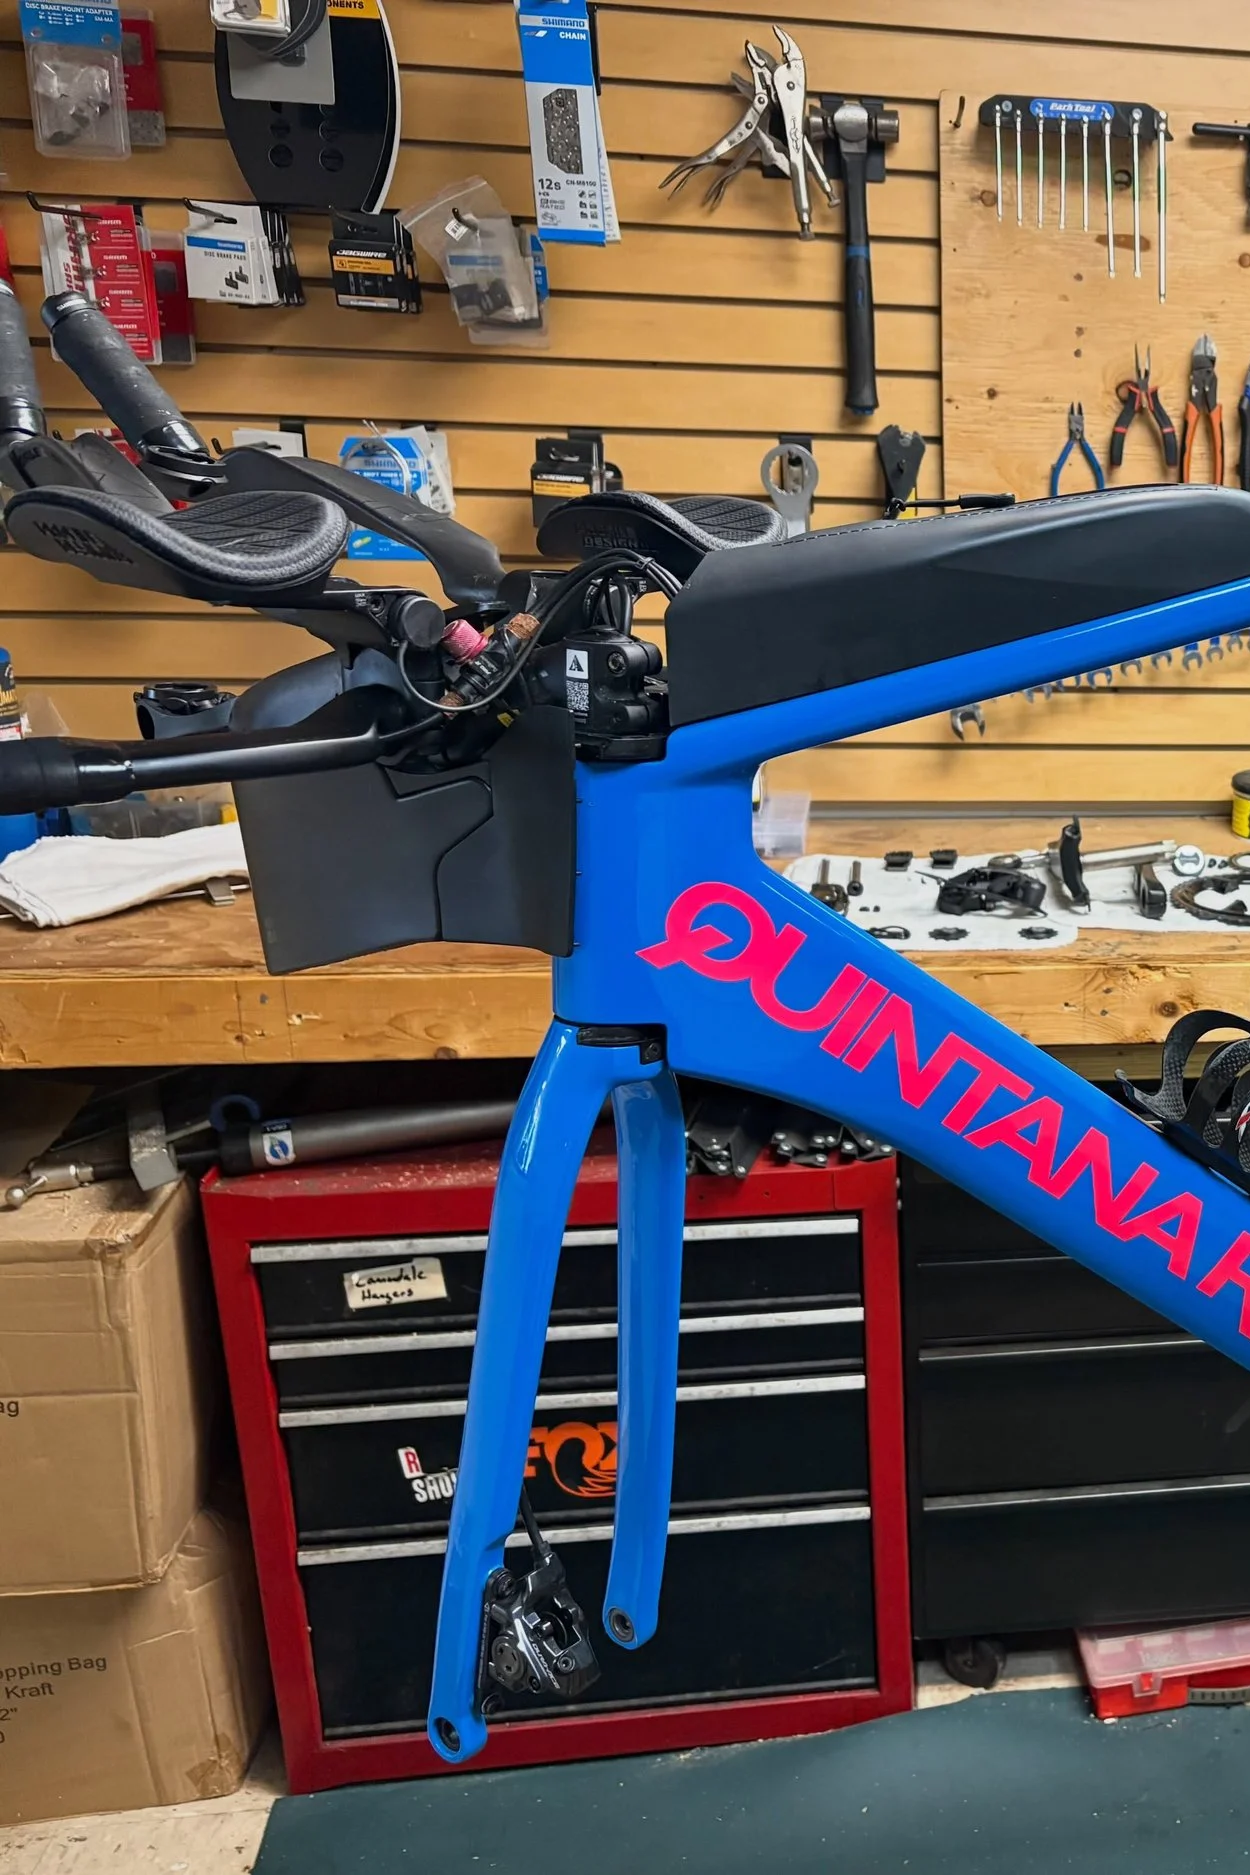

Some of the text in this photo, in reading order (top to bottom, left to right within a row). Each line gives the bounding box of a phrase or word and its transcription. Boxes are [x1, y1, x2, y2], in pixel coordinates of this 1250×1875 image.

[25, 2, 40, 10] DISC
[40, 4, 61, 12] BRAKE
[61, 6, 84, 14] MOUNT
[85, 8, 114, 16] ADAPTER
[541, 18, 585, 28] SHIMANO
[559, 31, 587, 40] CHAIN
[1049, 102, 1073, 112] Park
[639, 883, 1202, 1278] QUINTANA
[67, 1656, 108, 1672] Bag
[4, 1681, 55, 1700] Kraft
